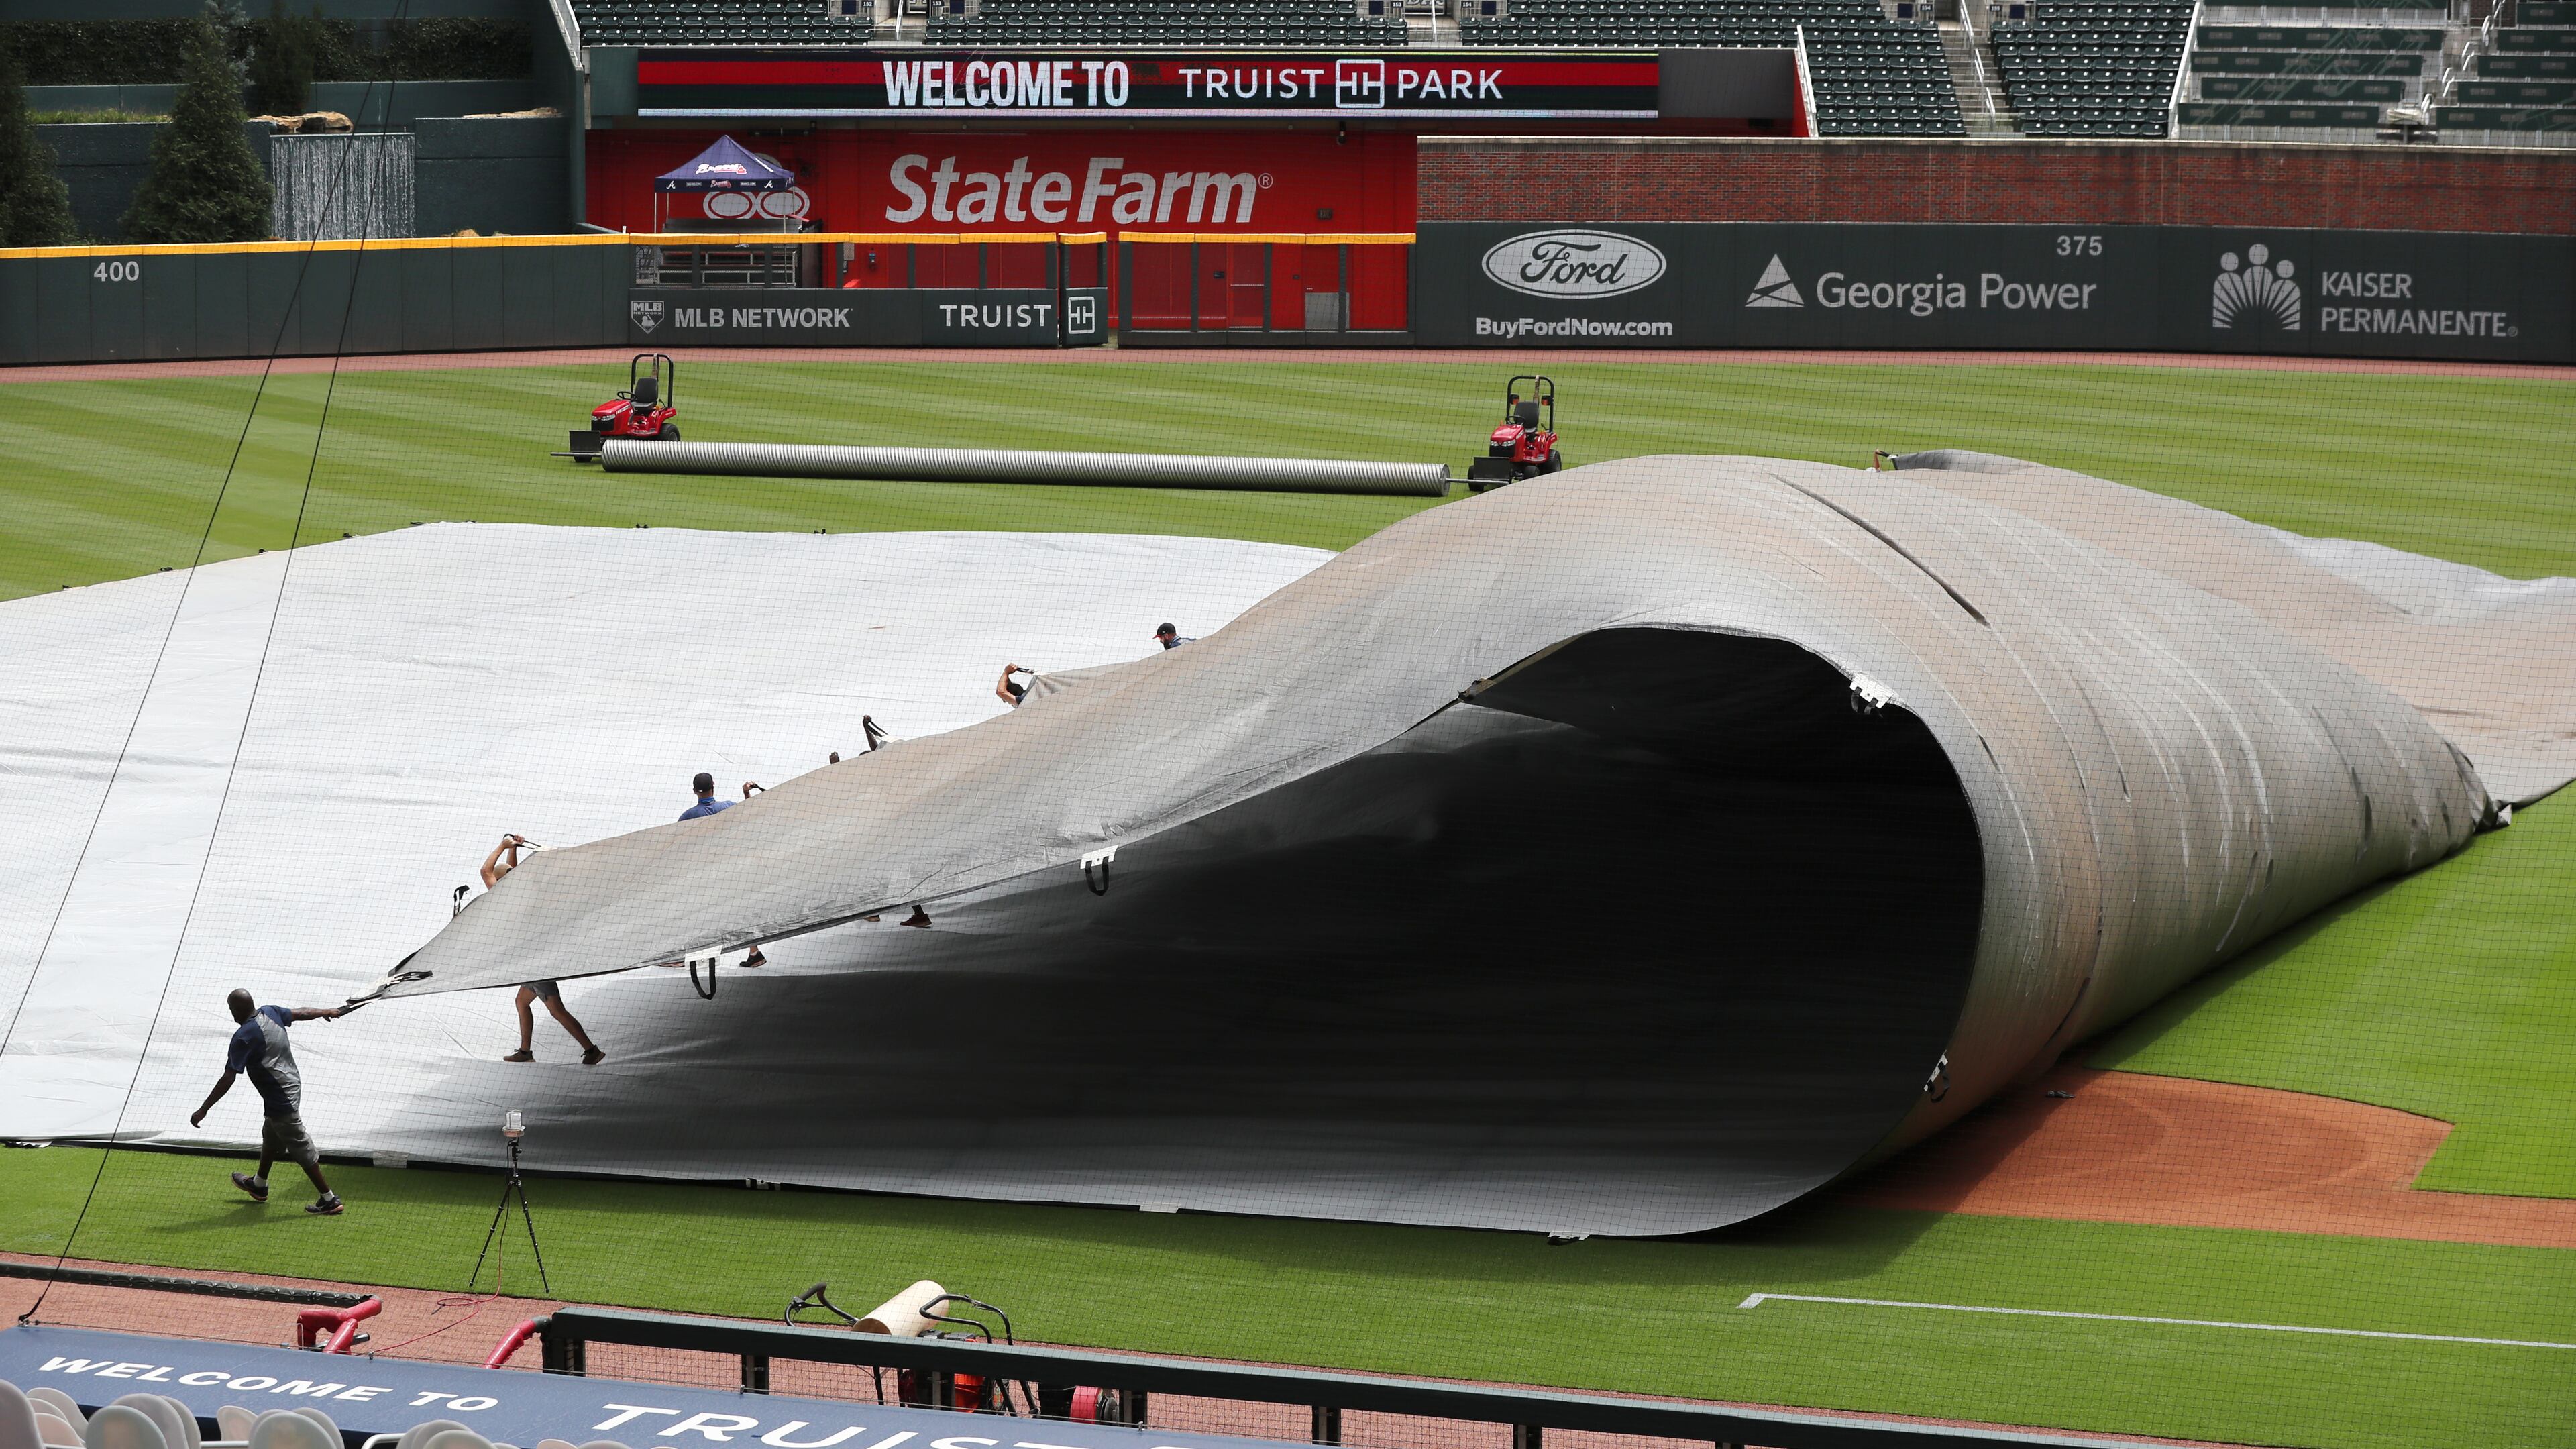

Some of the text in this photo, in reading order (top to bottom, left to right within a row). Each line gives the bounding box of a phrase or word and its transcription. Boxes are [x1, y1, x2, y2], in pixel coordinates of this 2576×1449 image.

[883, 60, 1503, 107] WELCOME TO TRUIST PARK
[2056, 236, 2102, 256] 375
[93, 260, 140, 282] 400
[1520, 241, 1628, 284] Ford
[1817, 272, 2096, 316] Georgia Power
[2322, 271, 2412, 298] KAISER
[633, 302, 662, 311] MLB
[674, 307, 851, 328] MLB NETWORK
[939, 304, 1052, 328] TRUIST
[1476, 317, 1673, 339] BuyFordNow.com
[38, 1356, 394, 1402] WELCOME
[409, 1391, 498, 1410] TO
